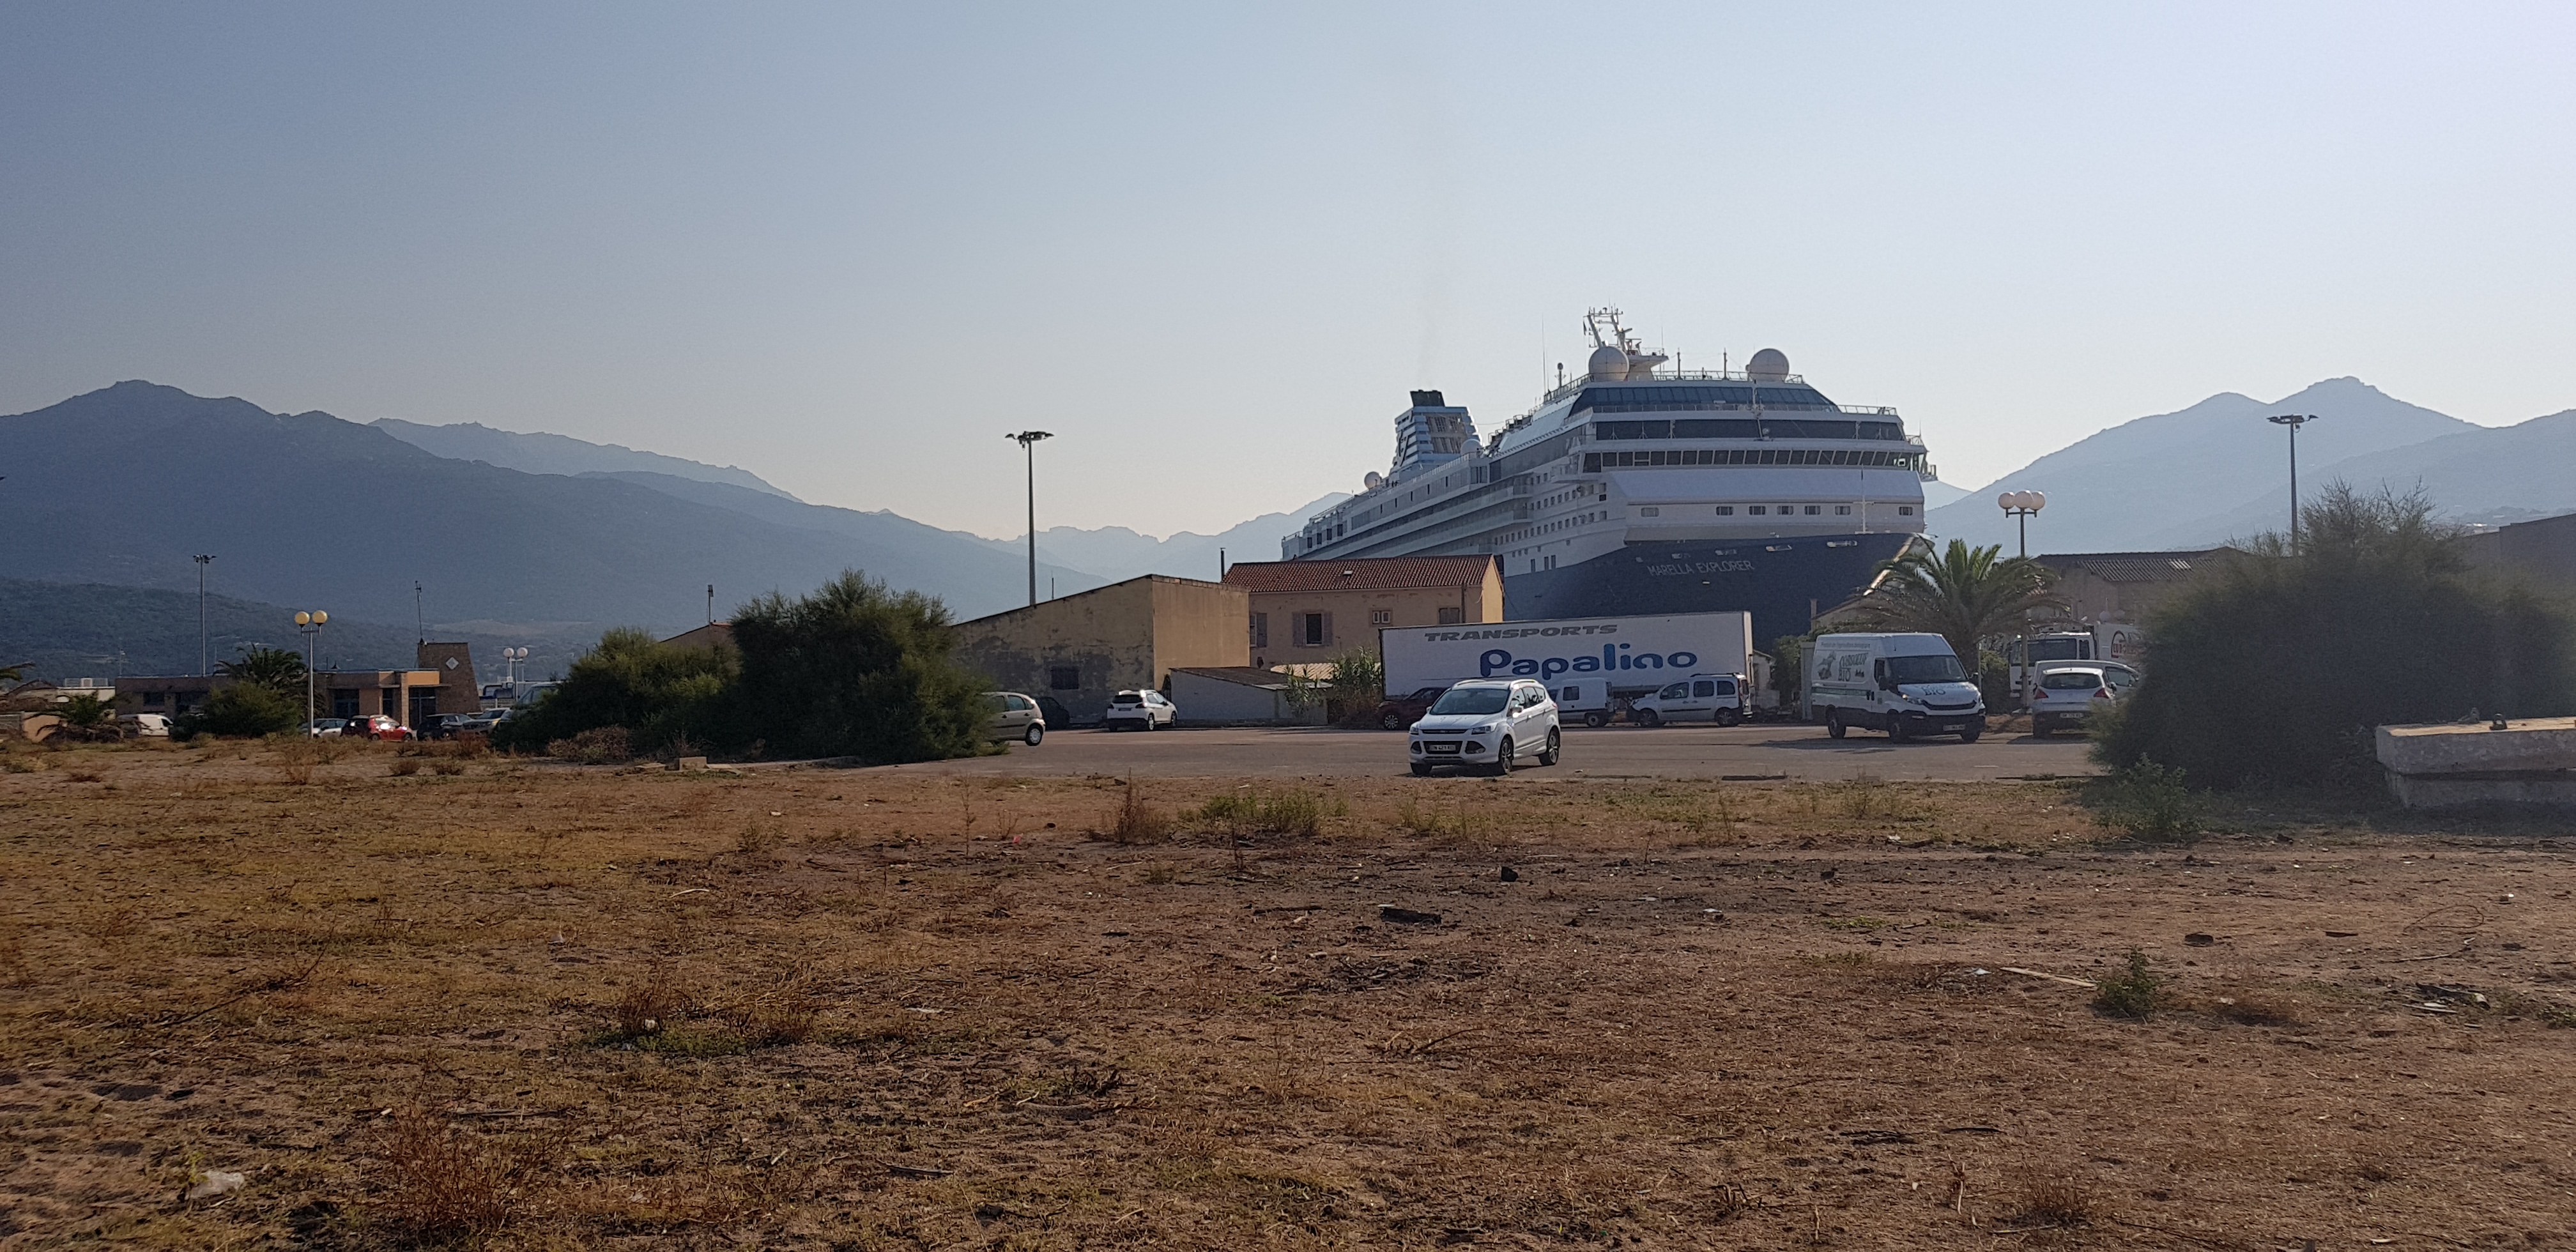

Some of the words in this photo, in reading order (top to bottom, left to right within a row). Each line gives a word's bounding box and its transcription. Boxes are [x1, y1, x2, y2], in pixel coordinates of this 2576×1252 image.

[1647, 563, 1694, 576] MARELLA
[1696, 560, 1754, 574] EXPLORER
[1424, 625, 1618, 641] TRANSPORTS
[1480, 643, 1698, 680] Papalino
